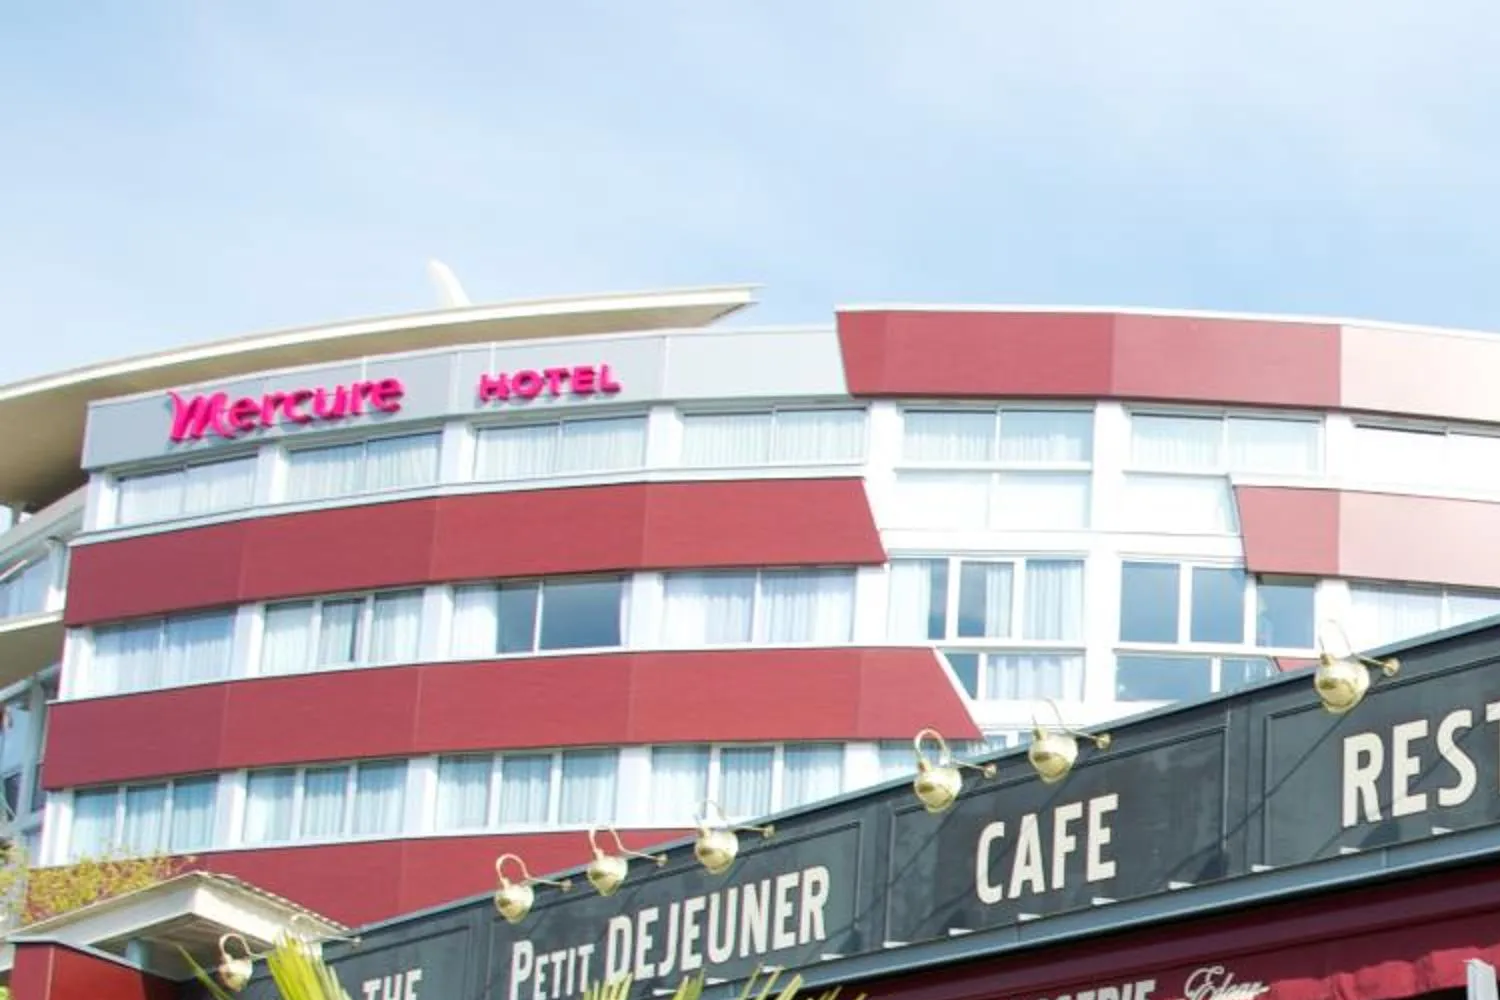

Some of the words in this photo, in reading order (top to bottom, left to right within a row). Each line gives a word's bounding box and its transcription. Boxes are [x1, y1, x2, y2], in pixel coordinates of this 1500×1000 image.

[168, 377, 404, 442] Mercure
[479, 366, 621, 401] HOTEL
[976, 793, 1119, 904] CAFE
[606, 866, 831, 985] DEJEUNER
